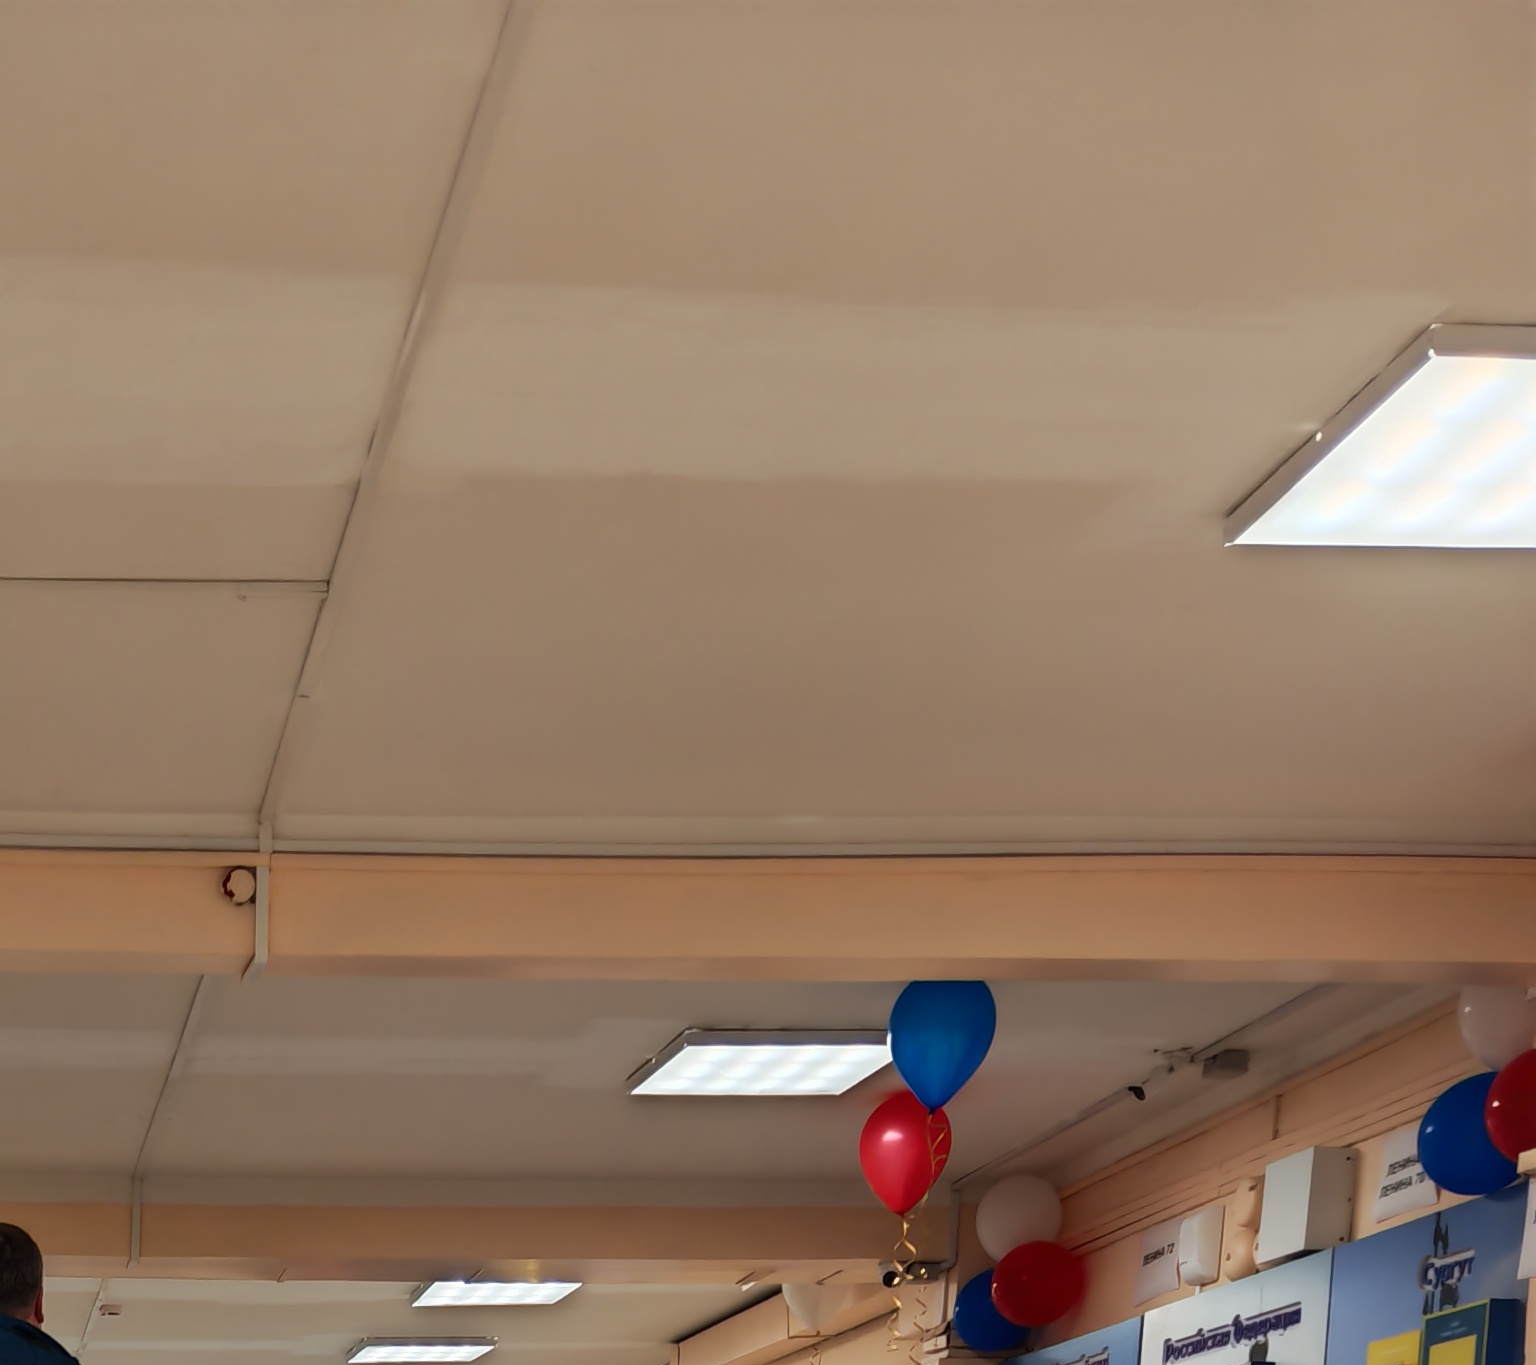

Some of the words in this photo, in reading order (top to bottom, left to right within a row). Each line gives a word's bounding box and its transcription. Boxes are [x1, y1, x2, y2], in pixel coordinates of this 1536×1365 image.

[1424, 1257, 1474, 1289] Сургут
[1165, 1329, 1231, 1364] Российская
[1233, 1307, 1302, 1344] Федерация
